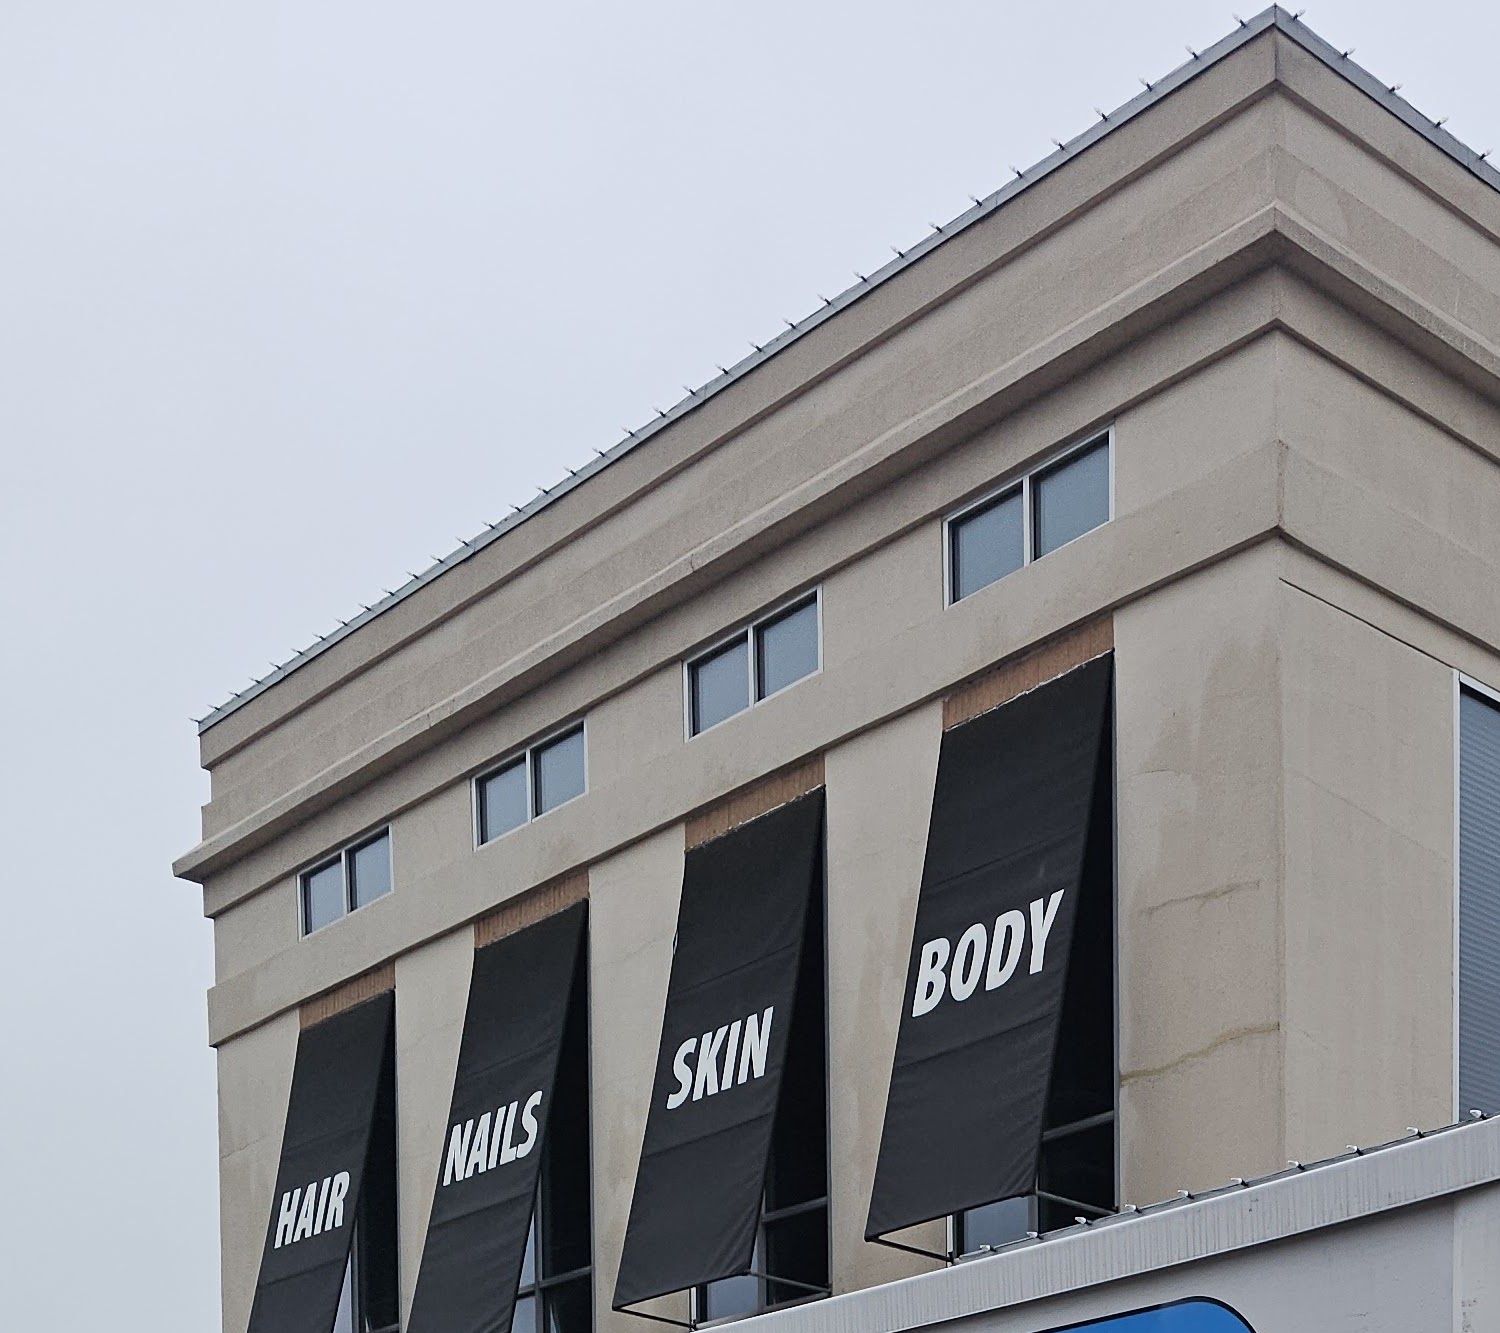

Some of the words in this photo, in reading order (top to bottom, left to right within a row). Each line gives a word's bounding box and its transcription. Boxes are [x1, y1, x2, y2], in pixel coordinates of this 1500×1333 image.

[912, 888, 1067, 1019] BODY
[665, 1006, 776, 1111] SKIN
[442, 1089, 543, 1188] NAILS
[273, 1171, 351, 1250] HAIR
